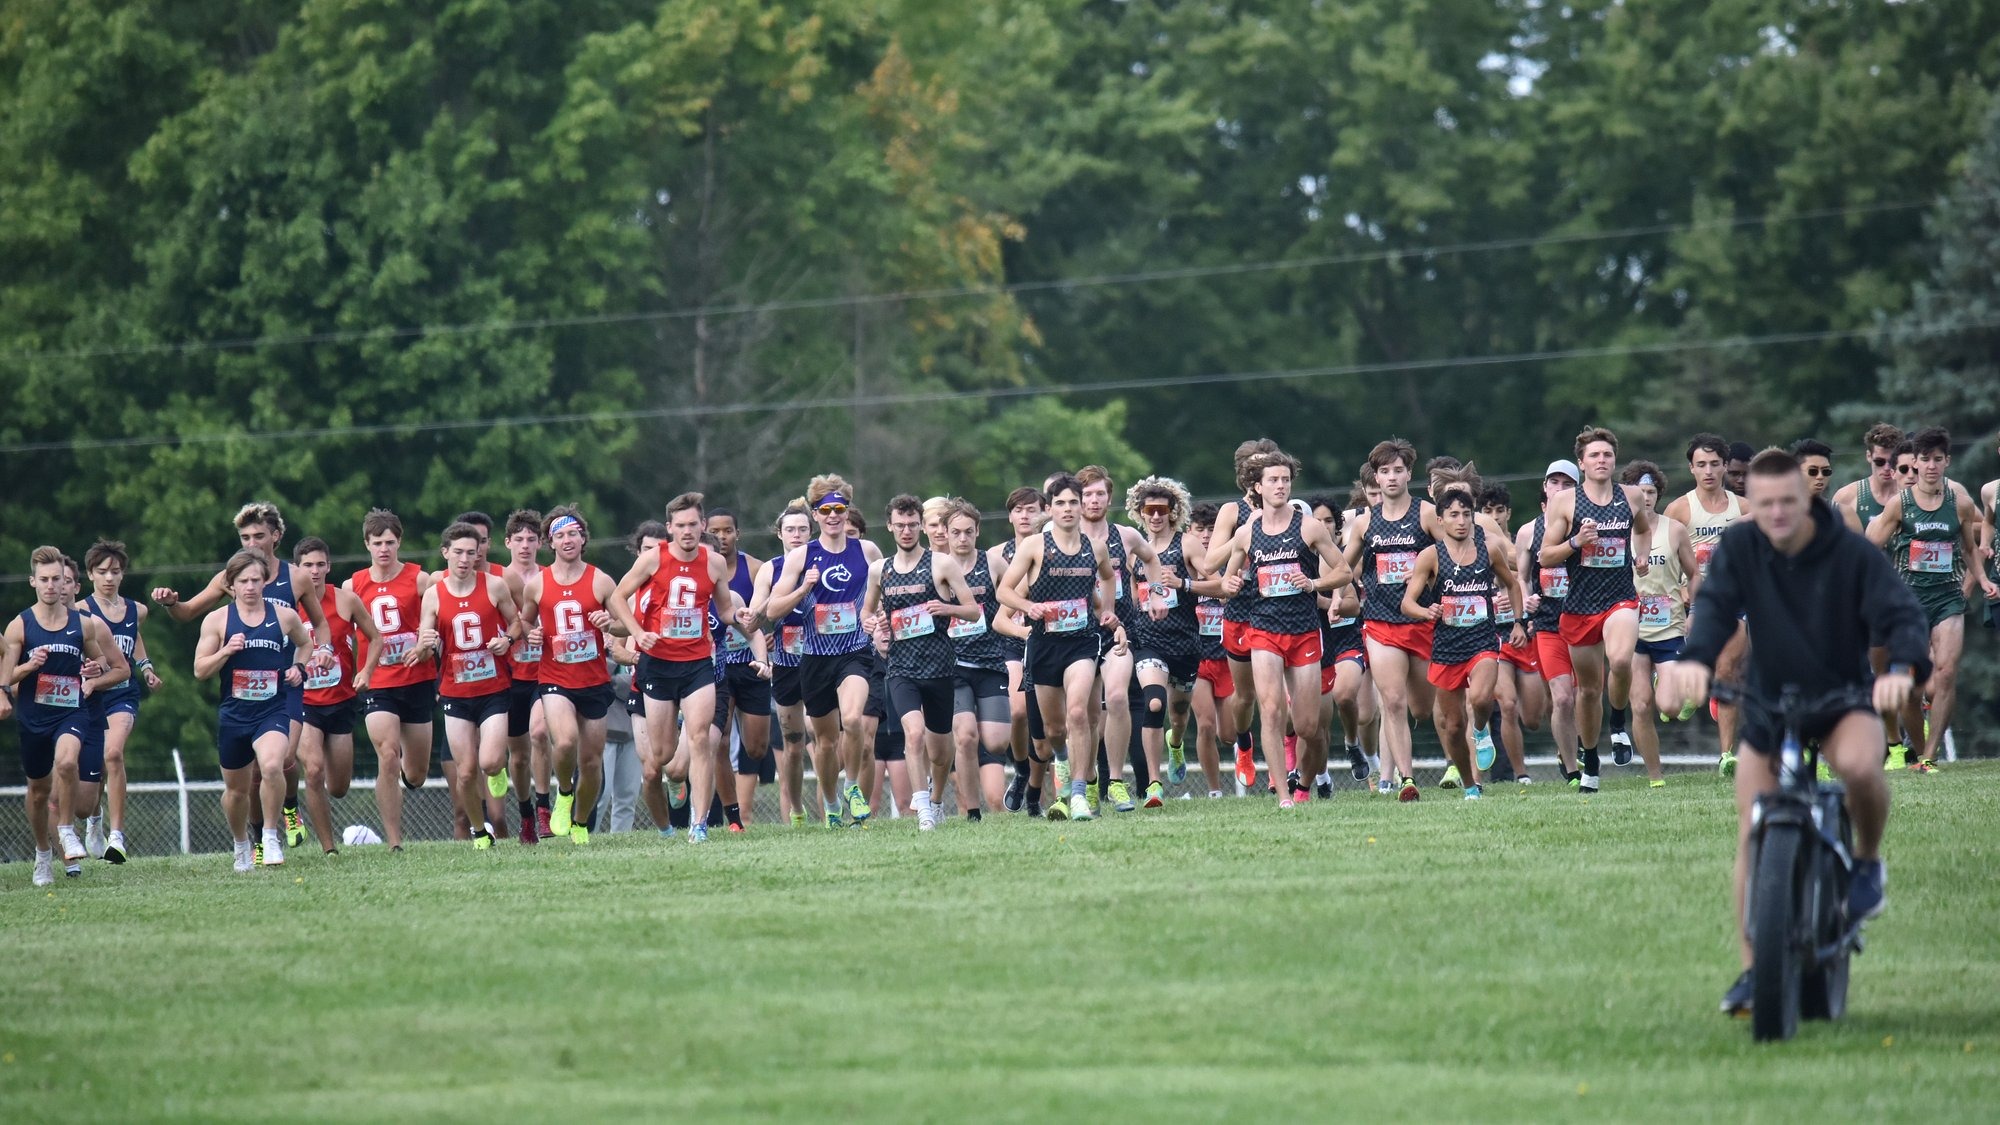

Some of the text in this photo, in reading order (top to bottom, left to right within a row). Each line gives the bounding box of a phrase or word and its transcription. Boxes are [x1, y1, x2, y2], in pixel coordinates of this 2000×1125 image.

[1370, 533, 1416, 548] Presidents
[1254, 547, 1299, 563] Presidents
[1592, 544, 1617, 557] 180
[1923, 550, 1939, 561] 21
[1385, 560, 1409, 573] 183
[1267, 572, 1291, 586] 179
[1443, 578, 1488, 592] Presidents
[667, 575, 698, 609] G
[370, 595, 401, 634] G
[831, 611, 841, 623] 3
[1452, 604, 1476, 616] 174
[553, 600, 585, 635] G
[672, 616, 692, 628] 115
[451, 611, 483, 650] G
[386, 641, 405, 656] 117
[46, 684, 71, 697] 216
[240, 678, 268, 691] 223
